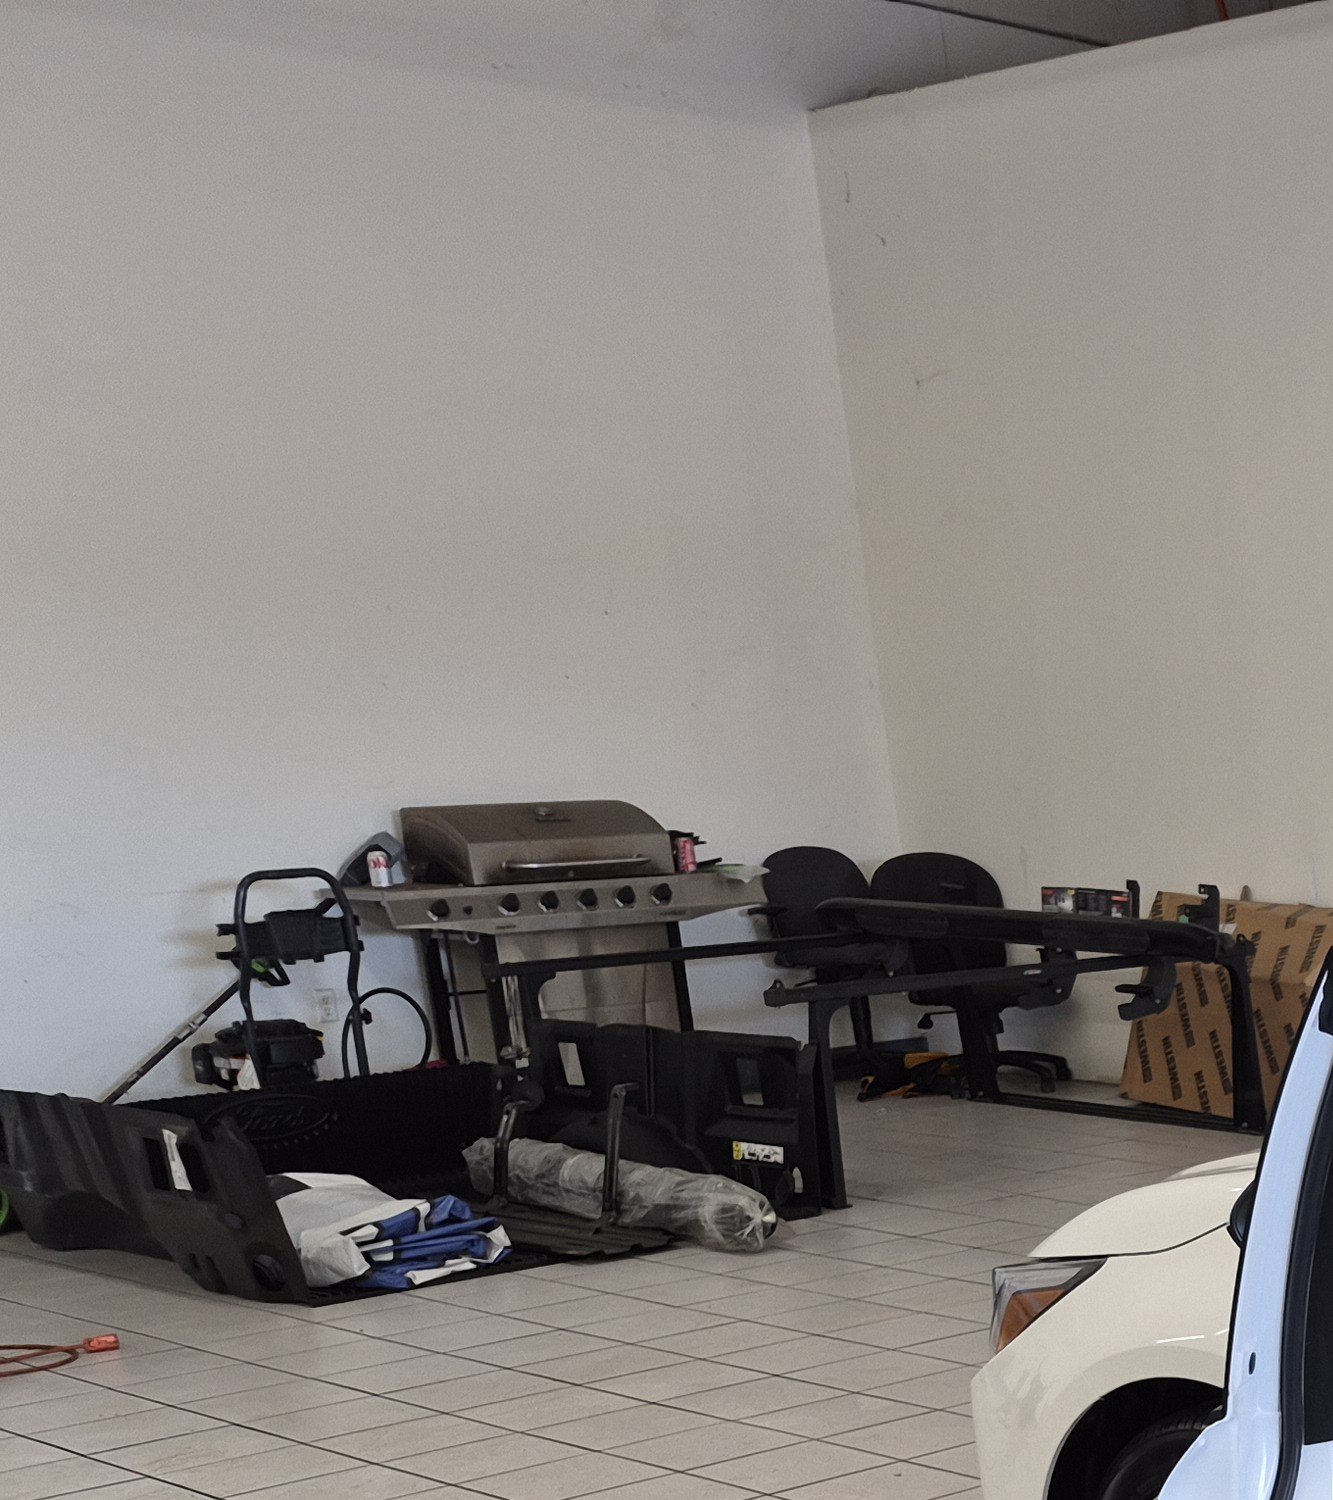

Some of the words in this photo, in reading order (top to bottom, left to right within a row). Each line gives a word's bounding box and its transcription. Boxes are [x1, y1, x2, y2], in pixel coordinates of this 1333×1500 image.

[1176, 982, 1193, 1034] WESTIN
[1254, 1008, 1275, 1059] WESTIN
[1136, 1019, 1150, 1069] WESTIN
[1162, 1035, 1181, 1086] WESTIN
[1209, 1029, 1229, 1081] WESTIN
